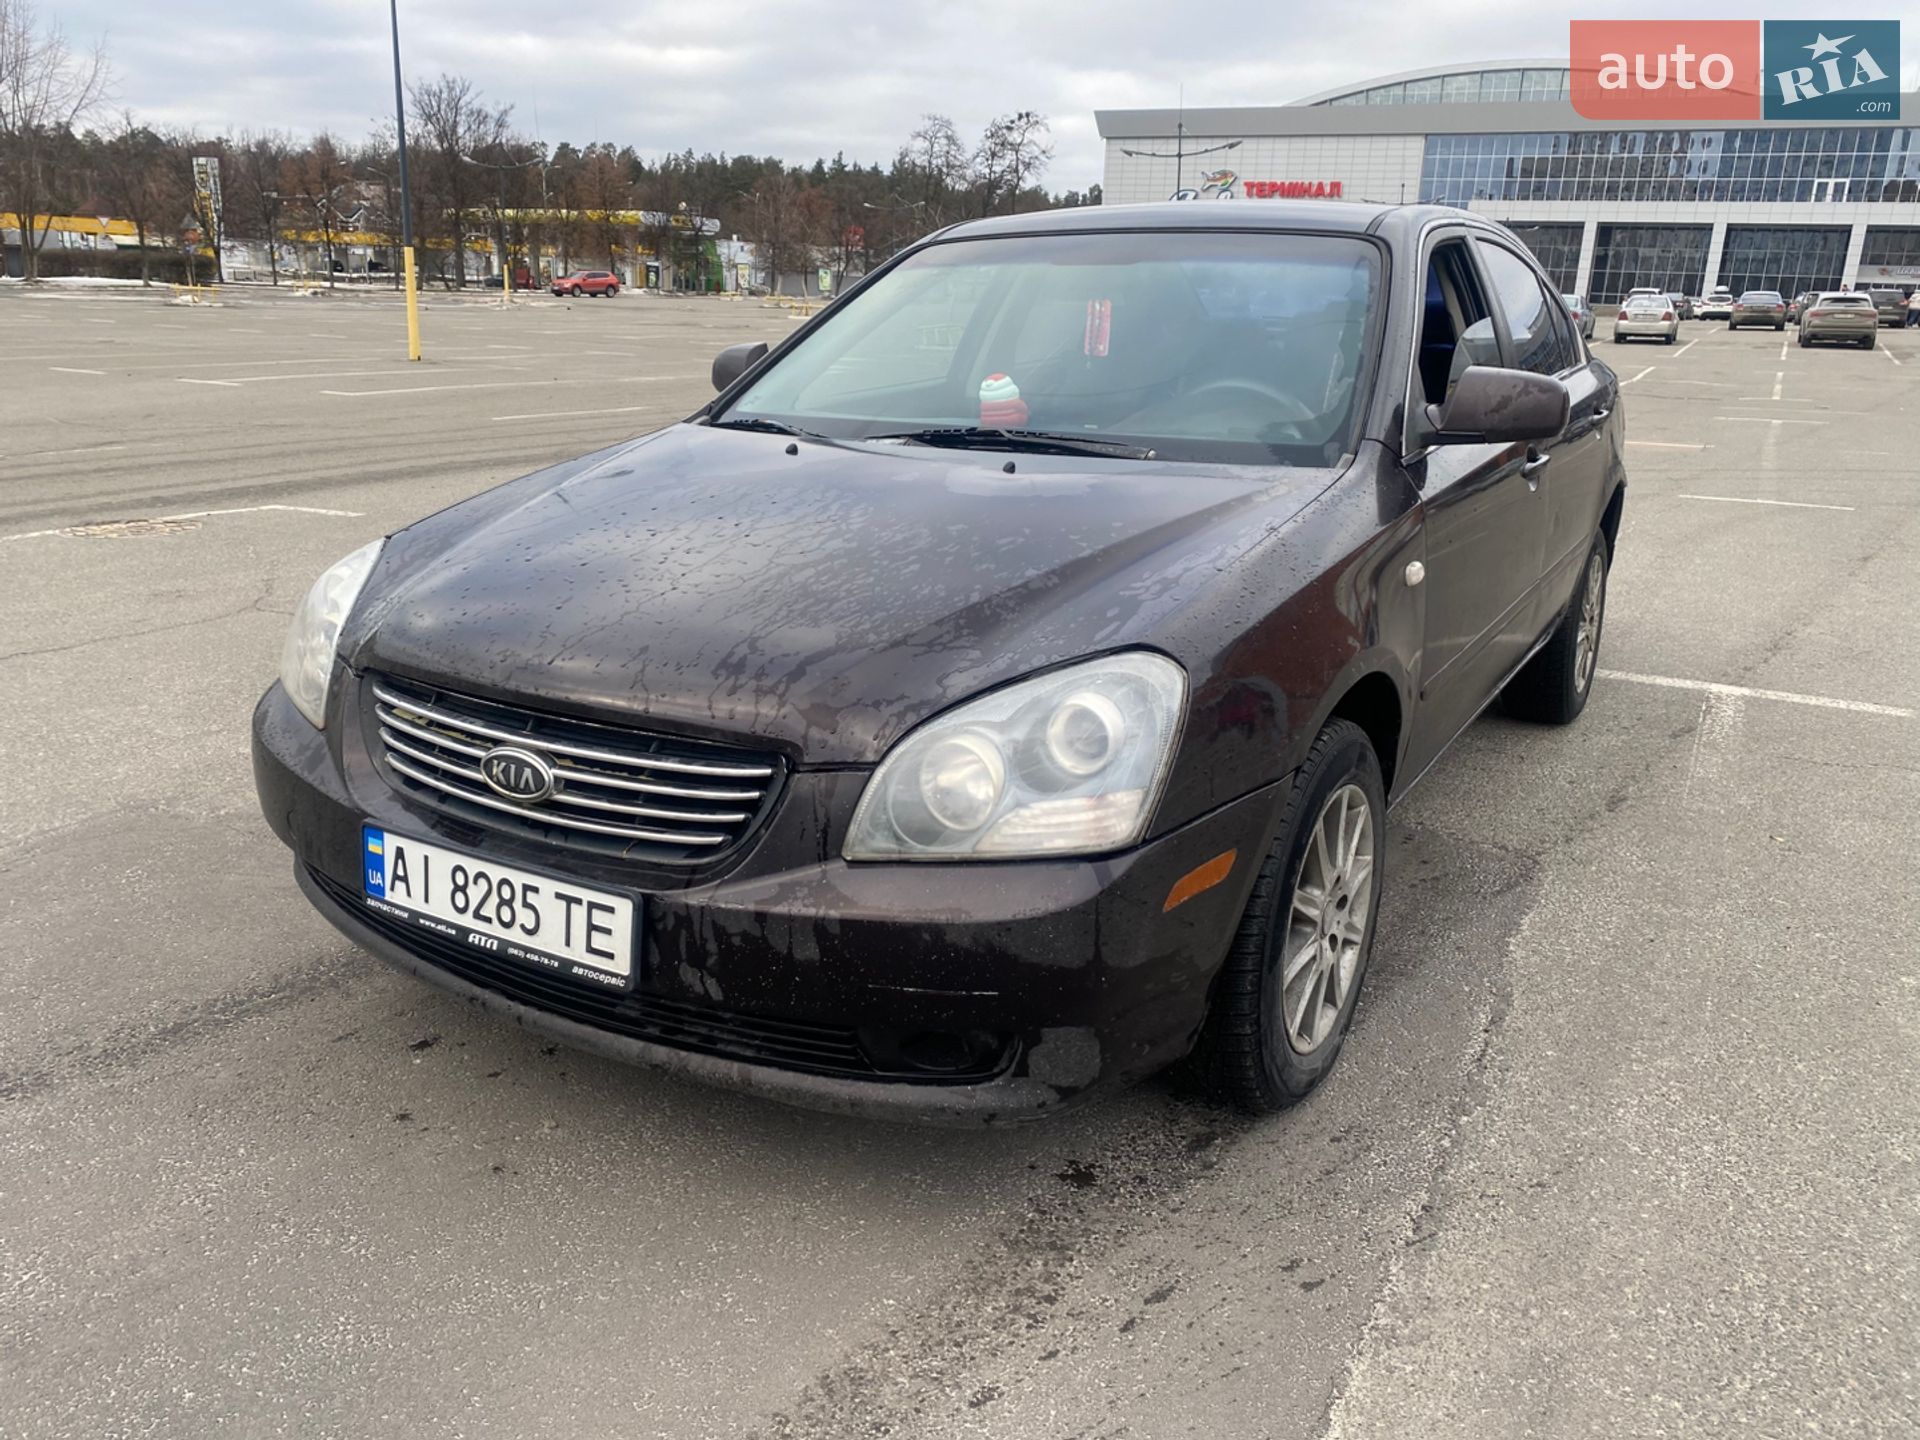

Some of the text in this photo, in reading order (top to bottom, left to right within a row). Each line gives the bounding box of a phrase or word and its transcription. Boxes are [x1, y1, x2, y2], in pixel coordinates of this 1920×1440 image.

[1243, 181, 1342, 199] ТЕРМІНАЛ
[491, 759, 537, 793] KIA
[369, 868, 384, 888] UA
[389, 846, 616, 961] AI 8285 TE
[572, 965, 627, 987] автосервіс
